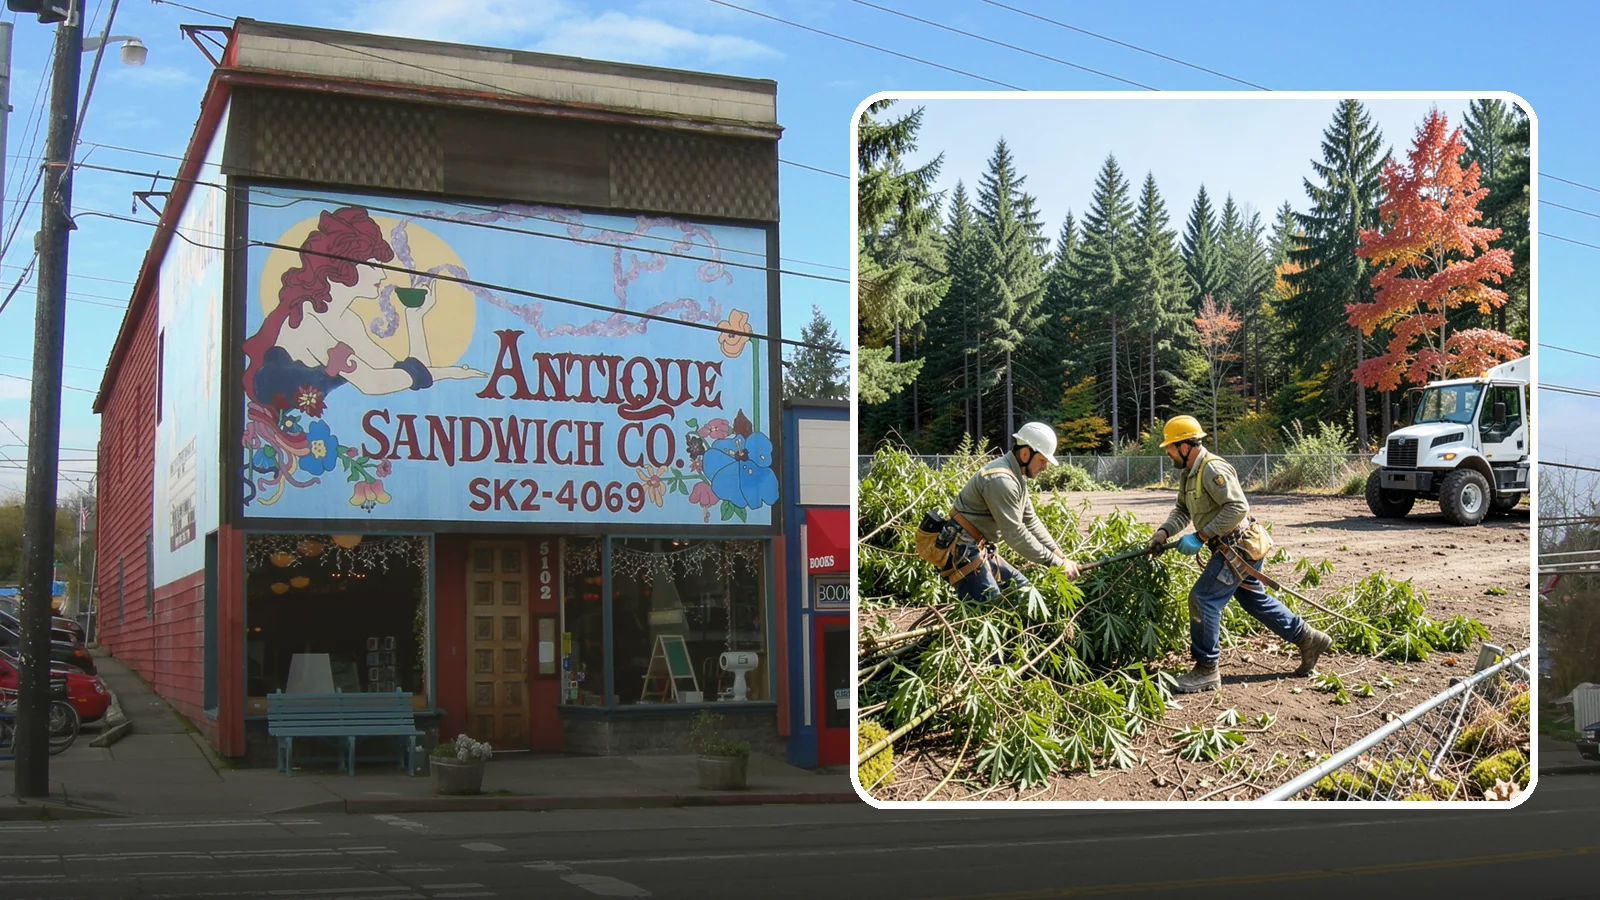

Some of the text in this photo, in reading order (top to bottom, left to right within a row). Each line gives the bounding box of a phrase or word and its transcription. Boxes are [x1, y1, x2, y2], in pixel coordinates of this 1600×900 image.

[475, 328, 723, 421] ANTIQUE
[361, 408, 684, 469] SANDWICH CO.
[469, 477, 645, 513] SK2-4069
[540, 541, 551, 600] 5102
[809, 554, 835, 569] BOOKS
